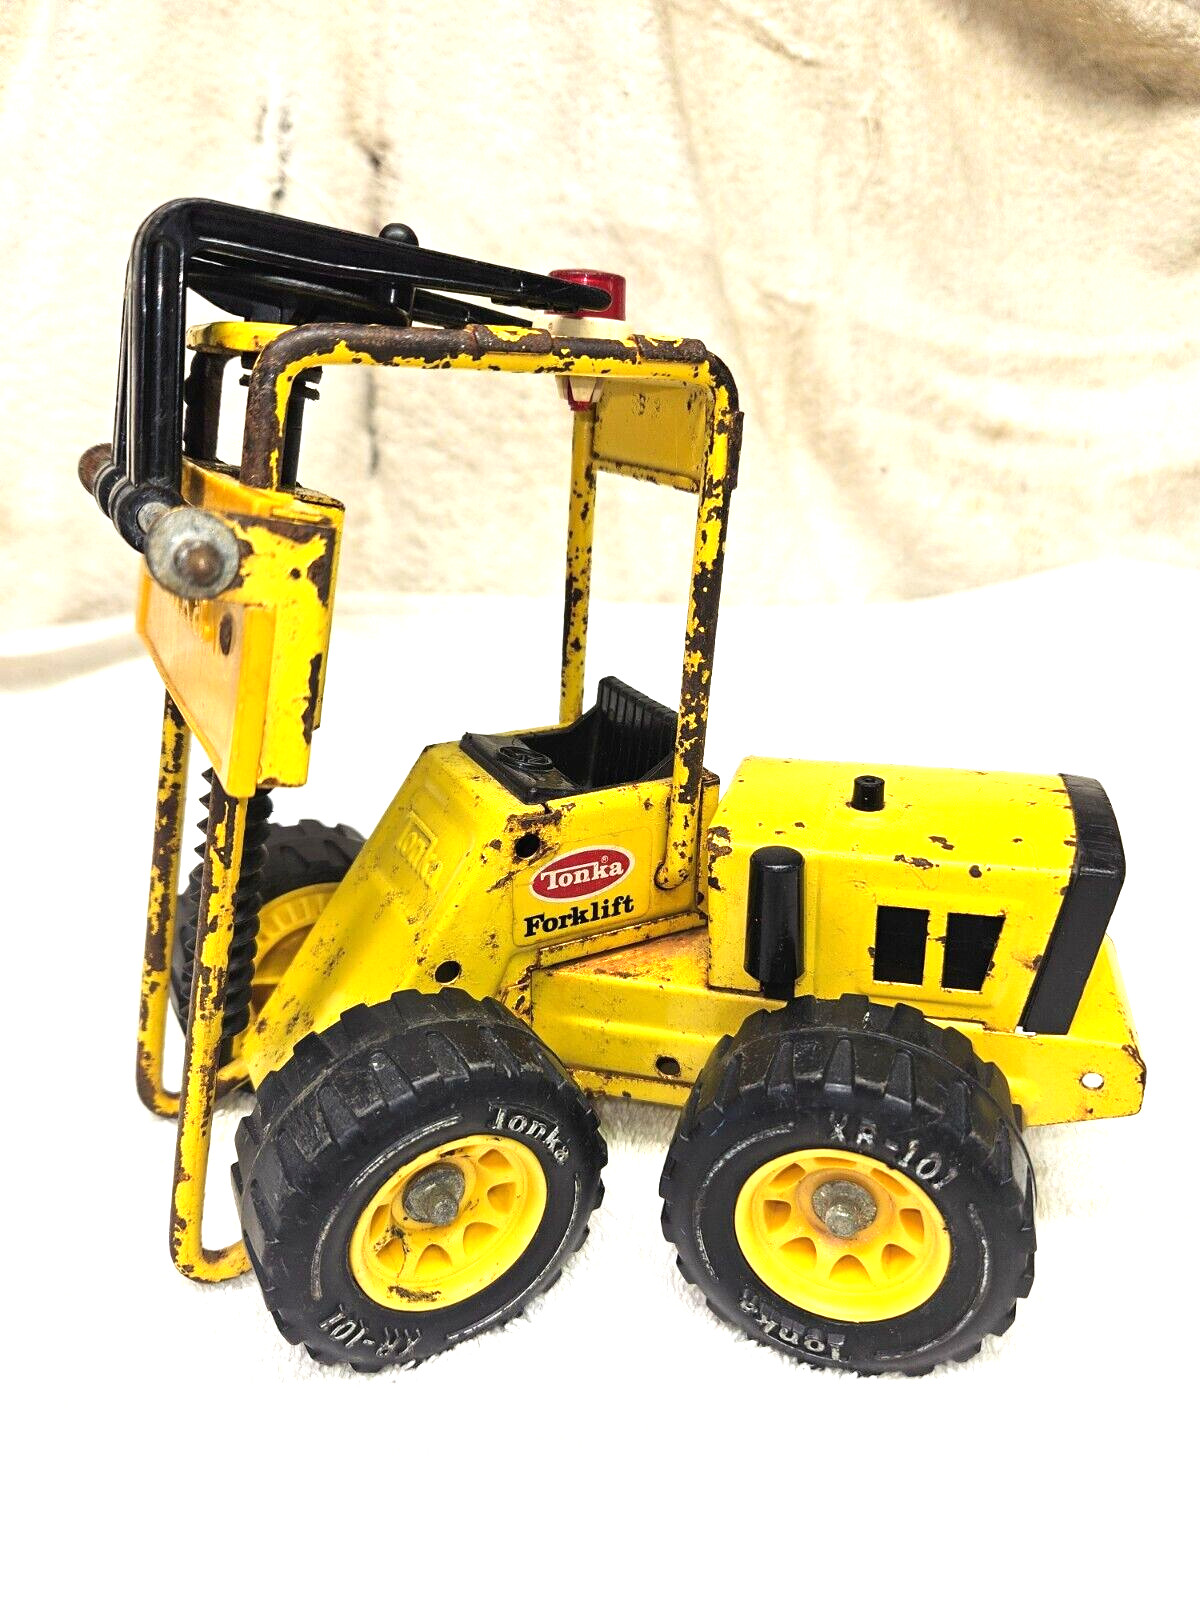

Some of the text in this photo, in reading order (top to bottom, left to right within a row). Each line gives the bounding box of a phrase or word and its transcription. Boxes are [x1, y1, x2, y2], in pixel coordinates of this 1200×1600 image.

[541, 861, 624, 891] Tonka
[523, 894, 635, 938] Forklift
[488, 1101, 571, 1166] Tonka
[829, 1110, 961, 1191] XR-101
[319, 1302, 423, 1359] XR-101
[739, 1284, 848, 1361] Tonka
